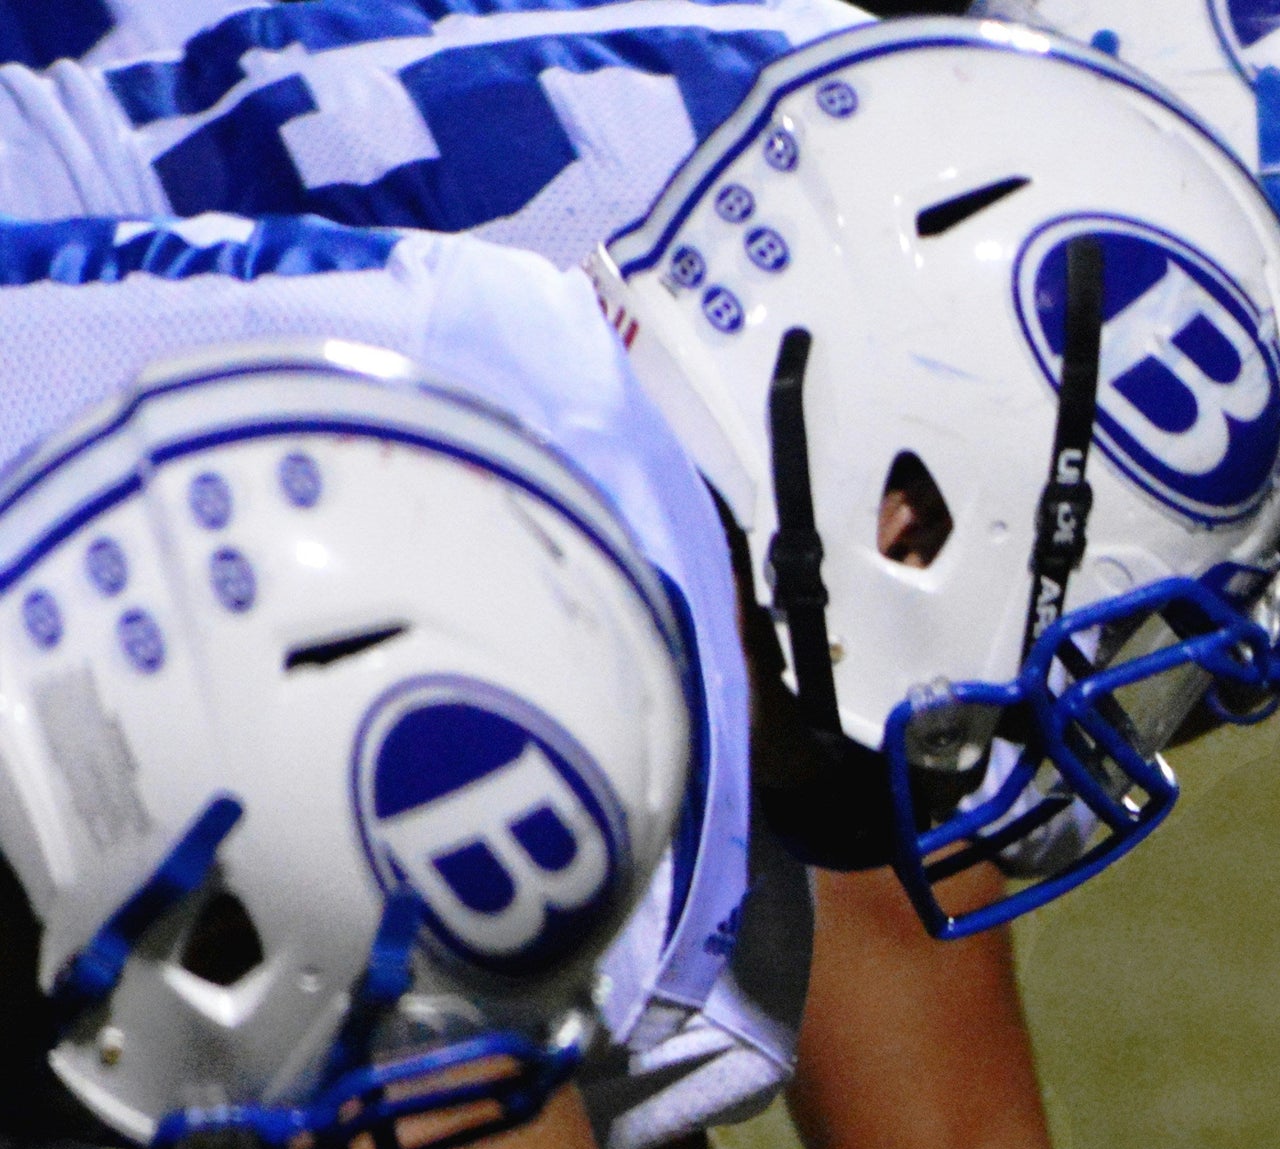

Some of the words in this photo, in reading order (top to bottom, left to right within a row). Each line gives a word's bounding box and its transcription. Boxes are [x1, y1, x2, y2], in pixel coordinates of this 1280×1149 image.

[703, 287, 743, 332] B
[747, 231, 788, 272] B
[1092, 257, 1271, 475] B
[376, 739, 609, 955] B
